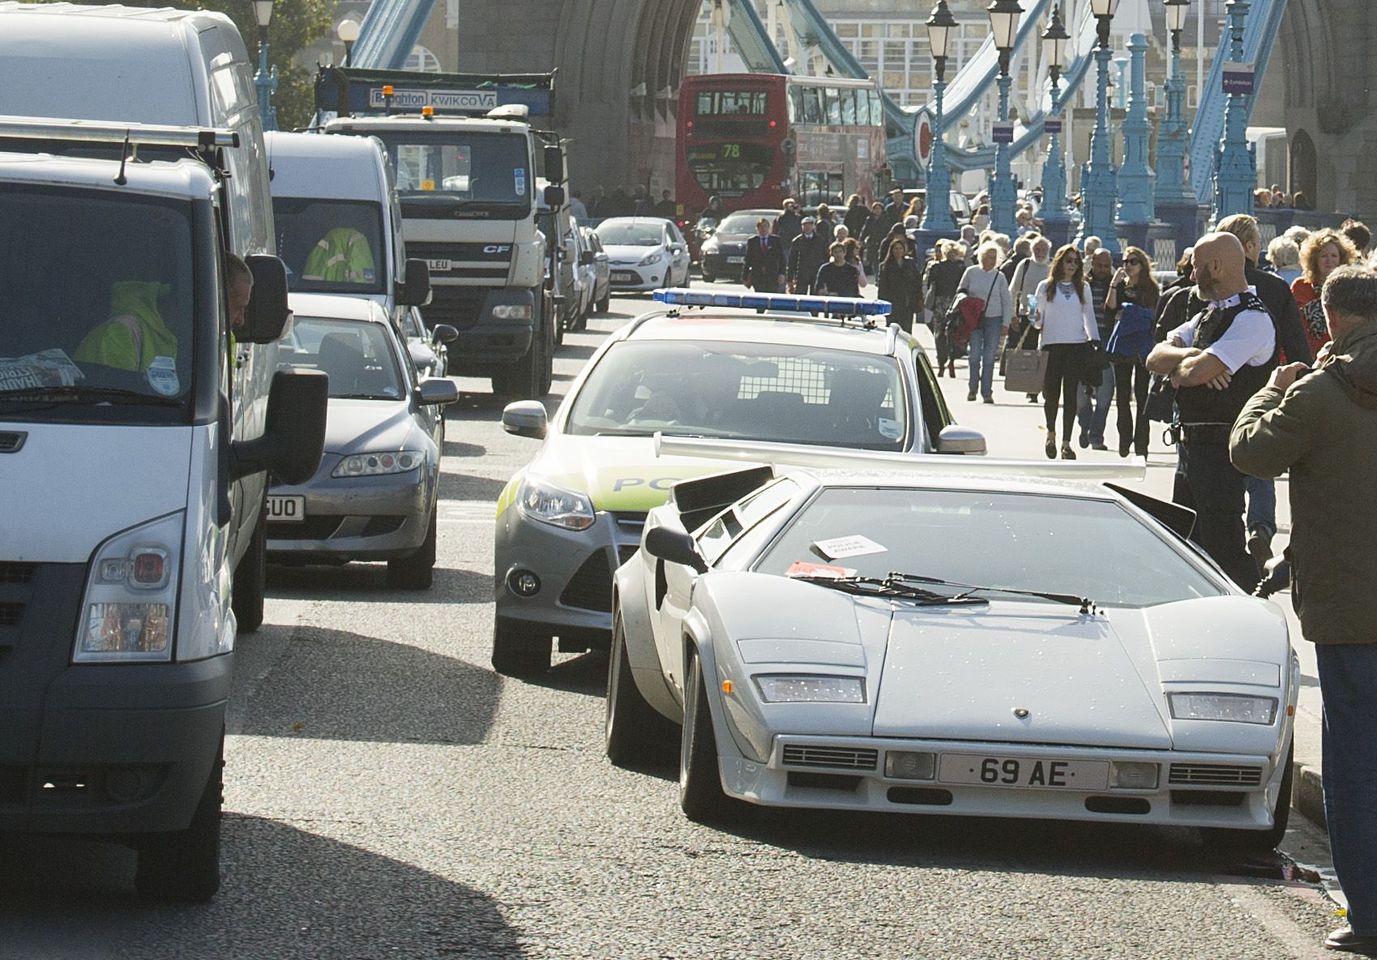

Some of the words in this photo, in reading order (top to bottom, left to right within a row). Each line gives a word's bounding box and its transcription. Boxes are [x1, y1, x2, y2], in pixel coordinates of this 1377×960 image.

[375, 92, 424, 105] Bughton
[723, 143, 740, 158] 78
[483, 245, 511, 253] CF
[265, 499, 296, 516] UO
[980, 758, 1020, 784] 69
[1028, 761, 1069, 786] AE
